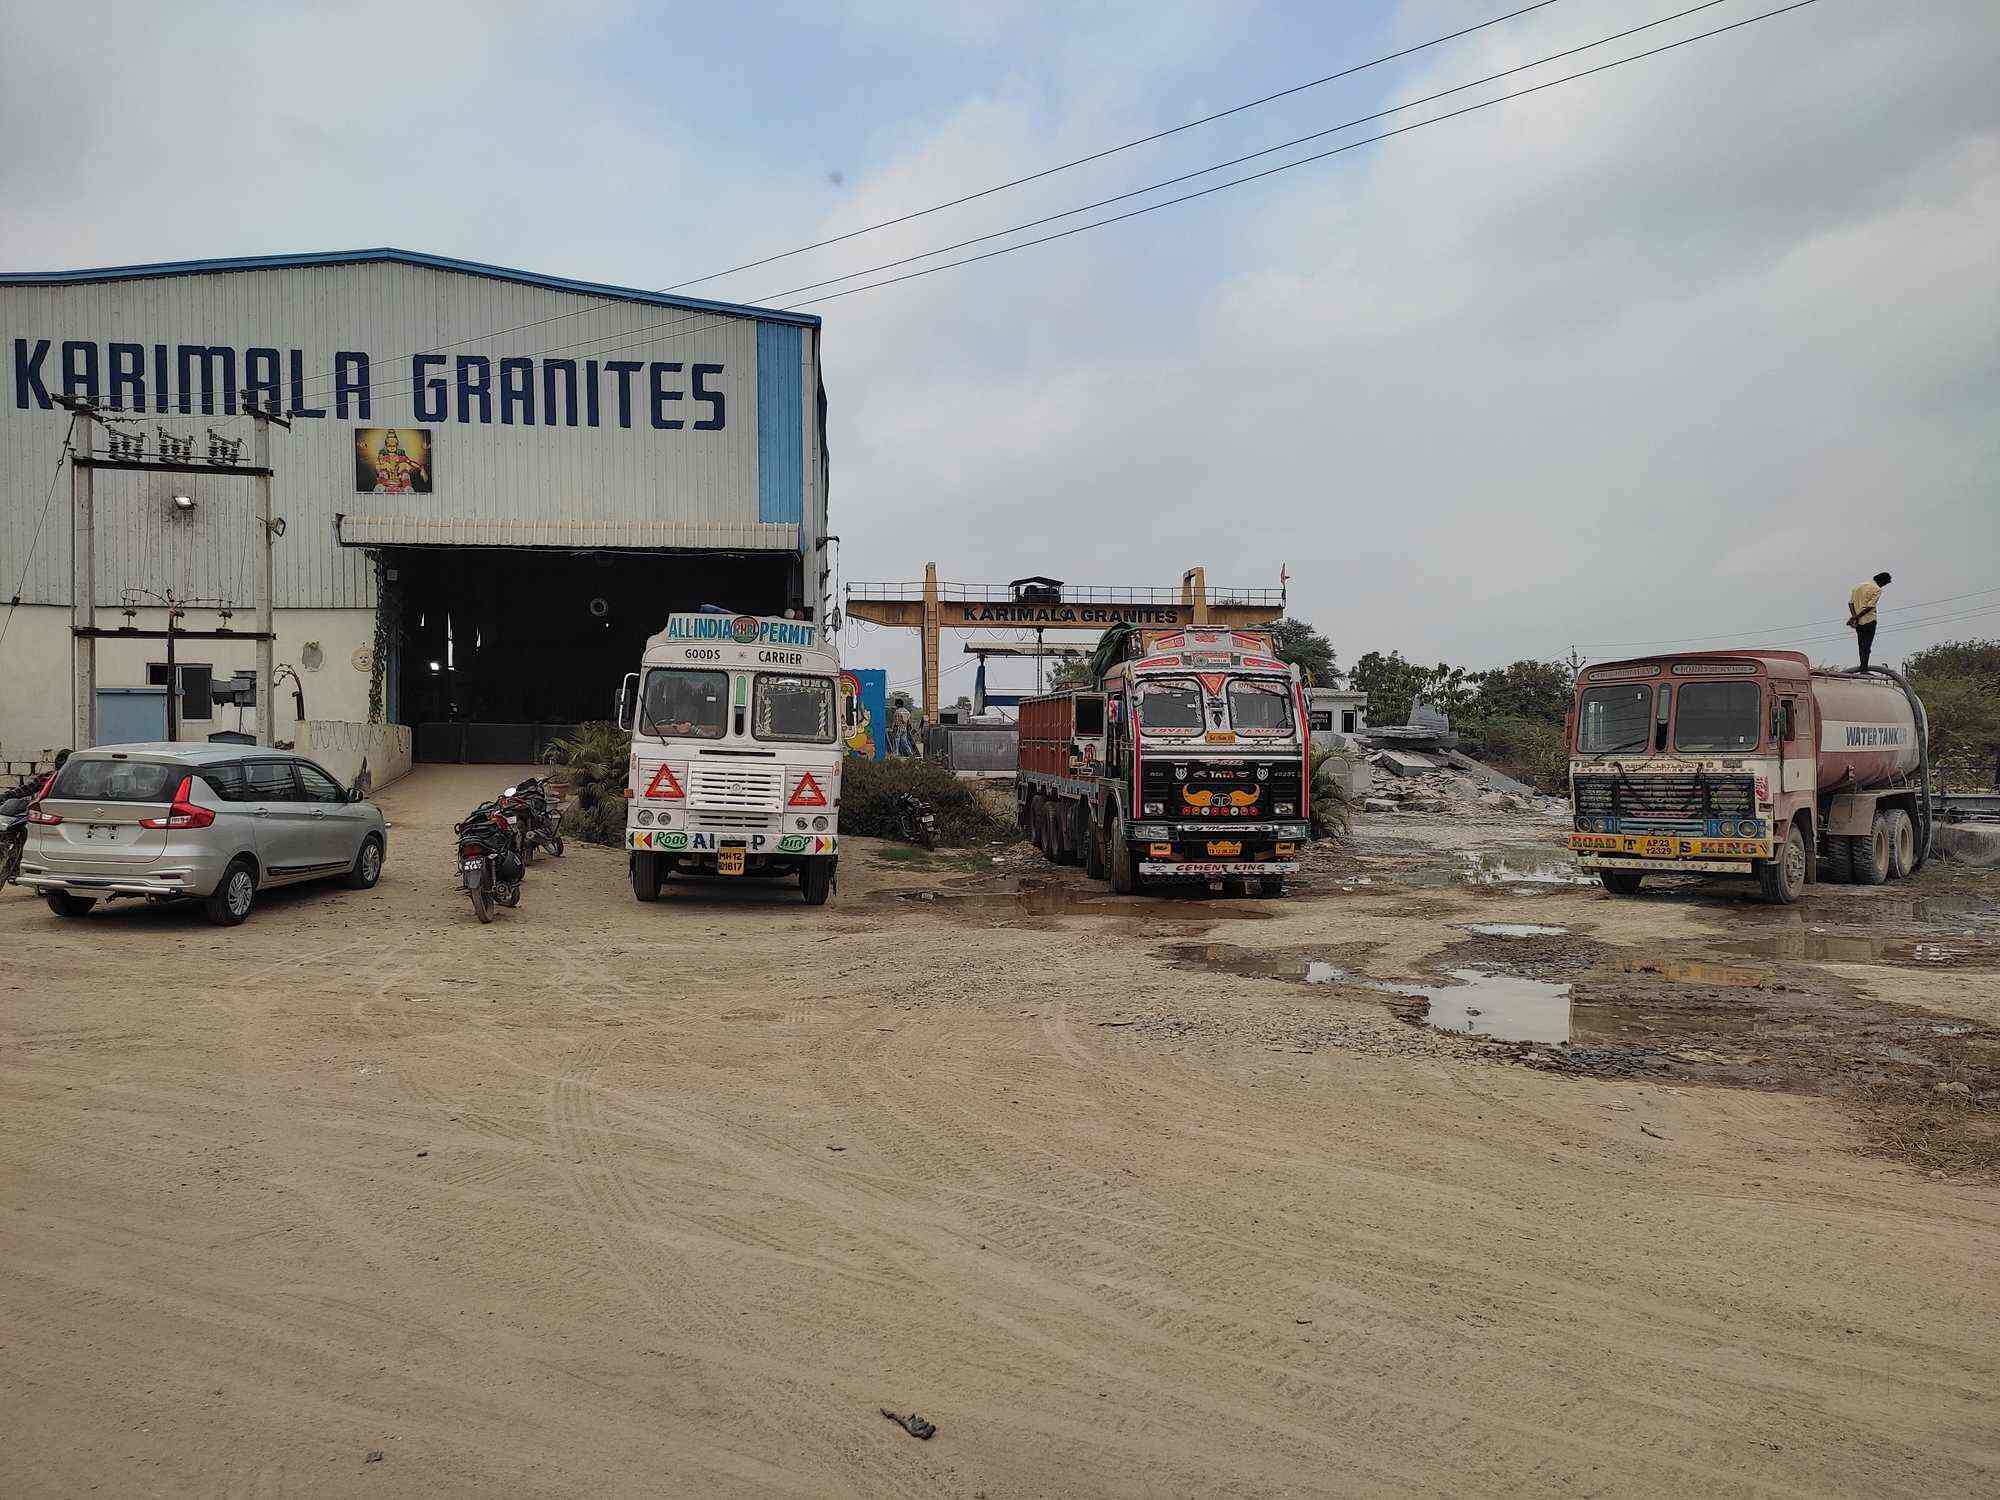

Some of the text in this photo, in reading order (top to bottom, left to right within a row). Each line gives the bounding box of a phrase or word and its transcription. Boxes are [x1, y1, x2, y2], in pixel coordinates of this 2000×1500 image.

[14, 338, 726, 431] KARIMALA GRANITES
[963, 606, 1179, 624] KARIMALA GRANITES
[759, 621, 816, 646] PERMIT
[685, 649, 803, 665] GOODS CARRIER
[1846, 727, 1878, 746] WATER
[1209, 770, 1234, 779] TATA
[1571, 835, 1617, 849] ROAD
[1700, 842, 1757, 855] KING
[1176, 864, 1266, 873] CEMENT KING
